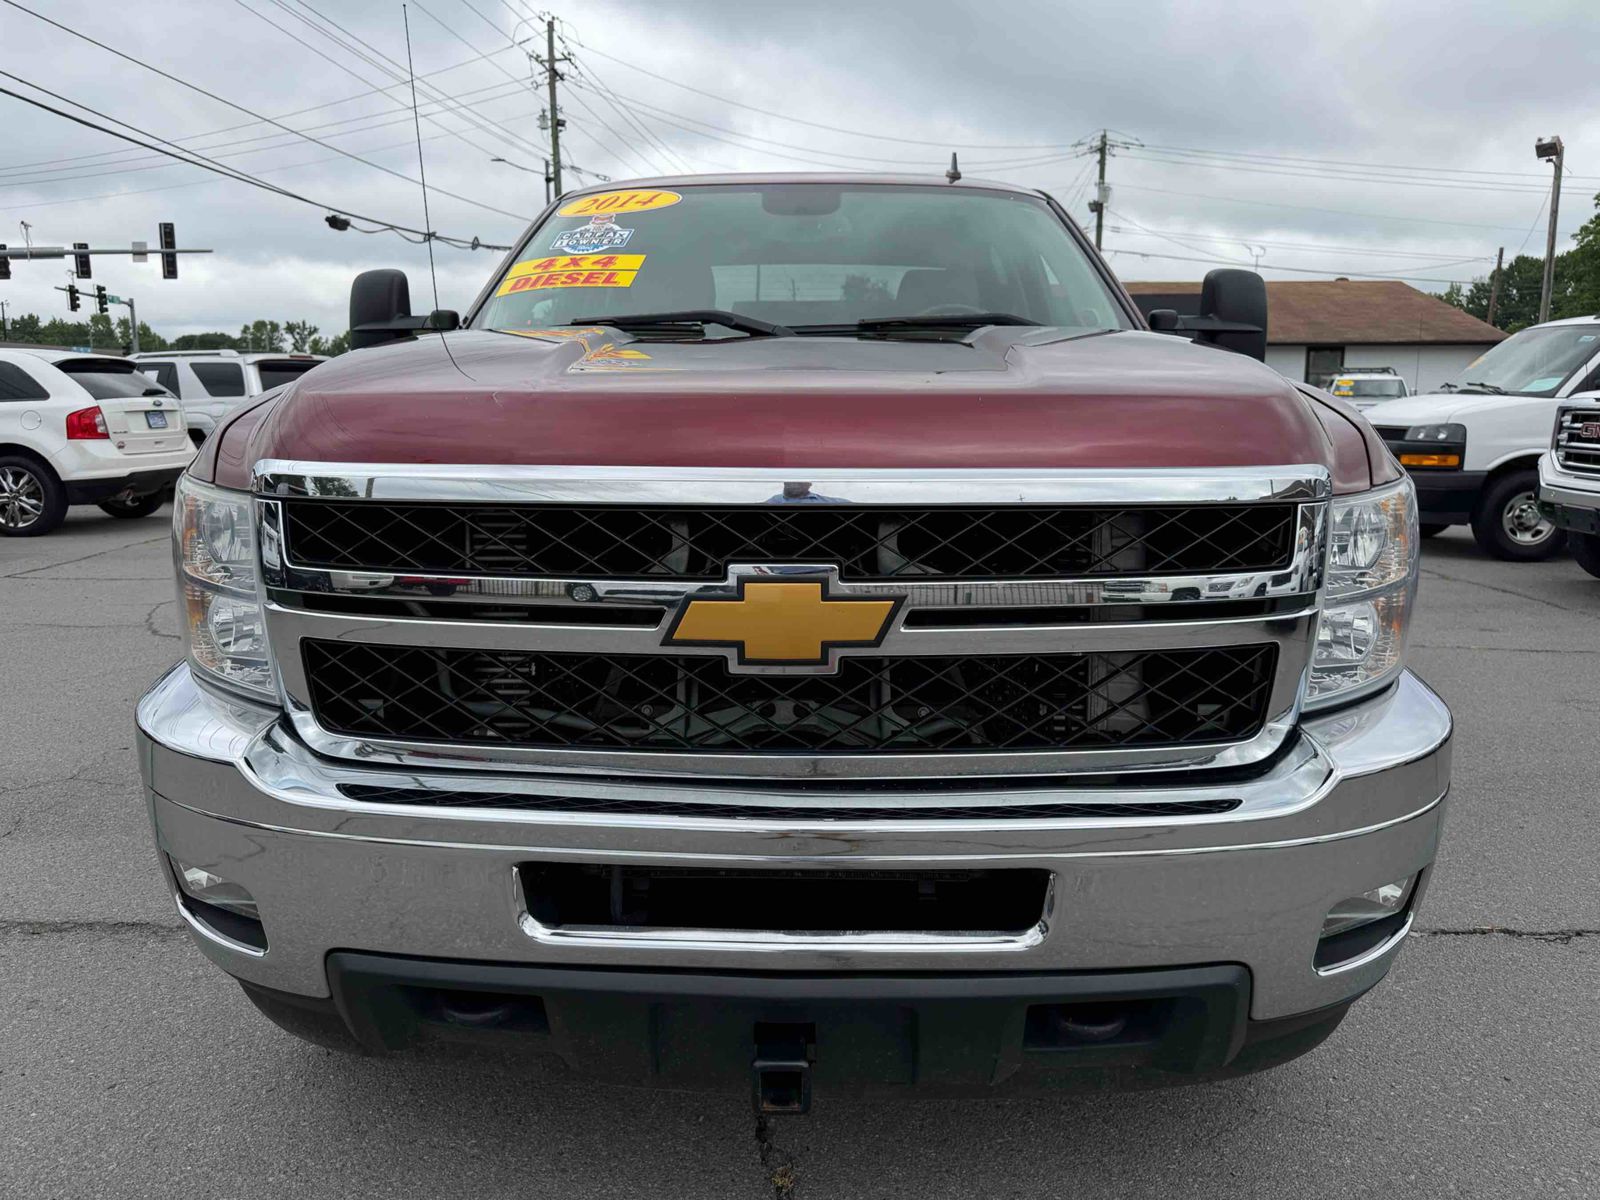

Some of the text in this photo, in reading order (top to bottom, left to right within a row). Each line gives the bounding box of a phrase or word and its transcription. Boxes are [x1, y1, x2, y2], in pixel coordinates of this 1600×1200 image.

[574, 192, 663, 214] 2014
[562, 230, 629, 239] CARFAX
[569, 238, 622, 246] OWNER
[508, 271, 619, 292] DIESEL
